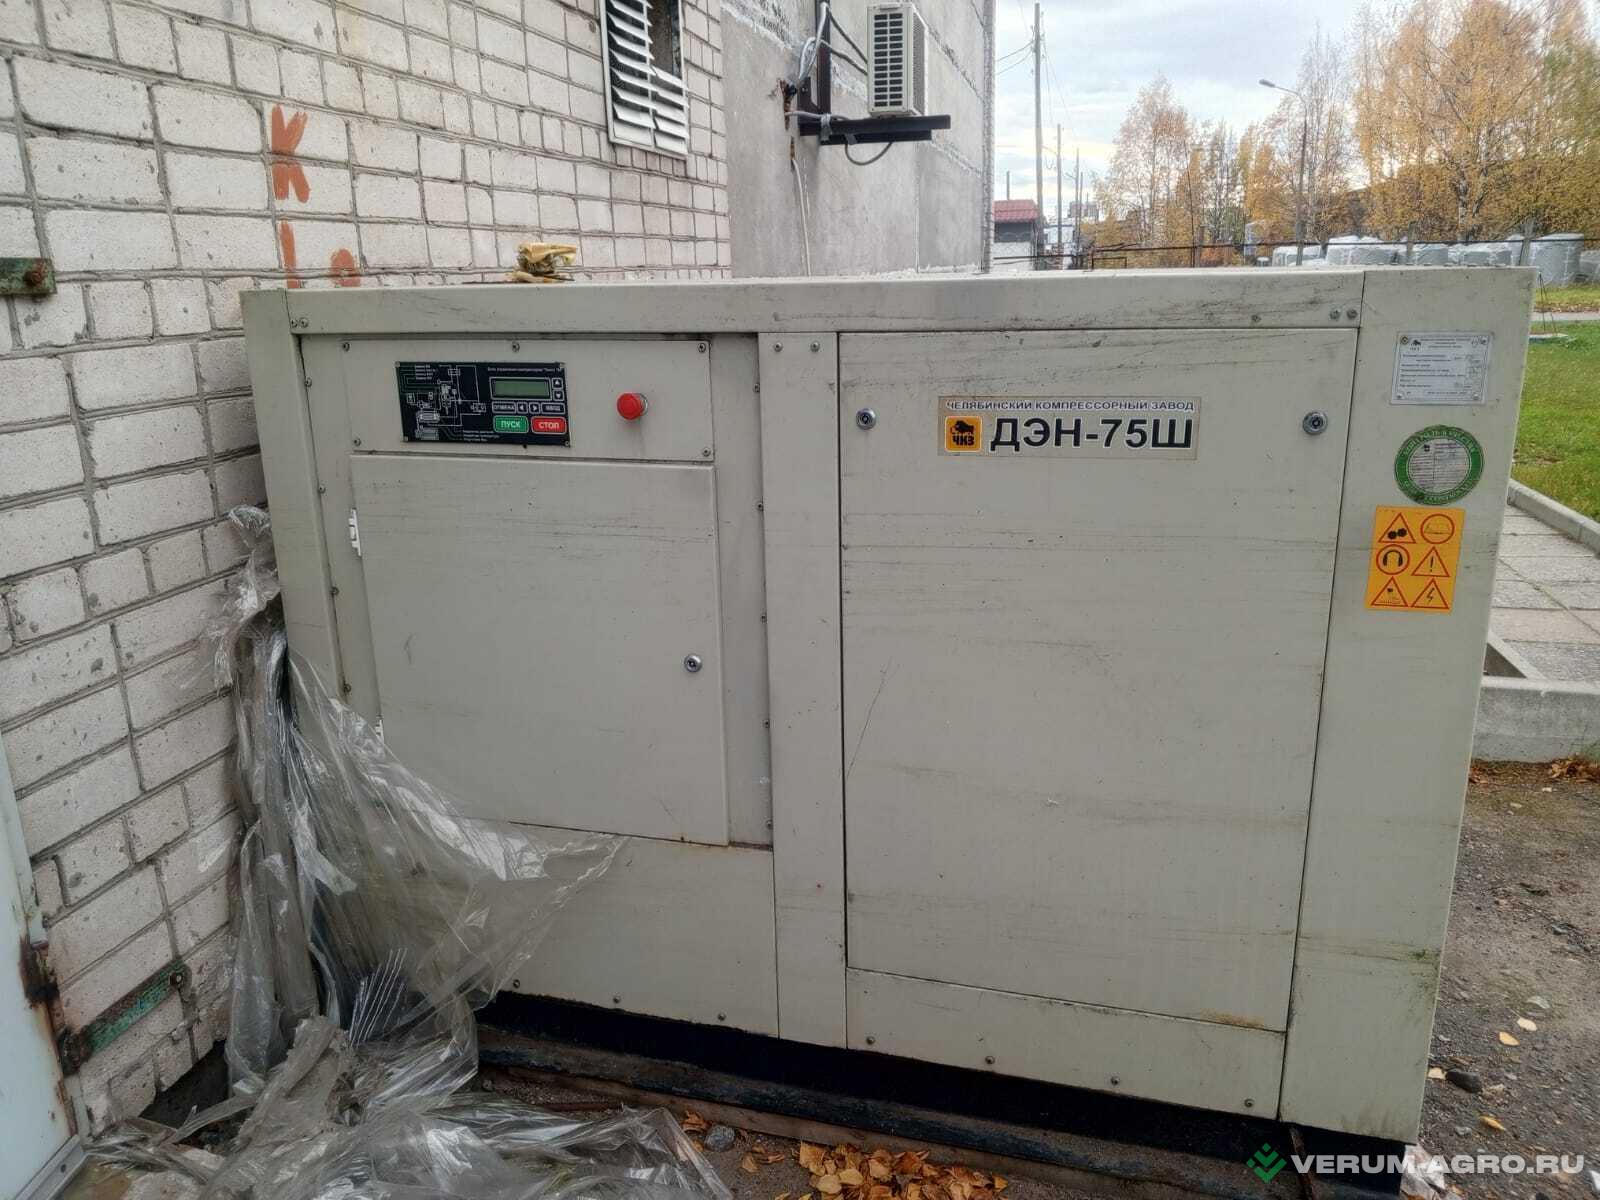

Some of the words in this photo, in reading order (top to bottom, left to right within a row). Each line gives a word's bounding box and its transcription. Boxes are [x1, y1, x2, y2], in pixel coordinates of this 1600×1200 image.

[946, 399, 1033, 412] ЧЕЛЯБИНСКИЙ
[1035, 399, 1149, 412] КОМПРЕССОРНЫЙ
[1151, 400, 1195, 412] ЗАВОД
[500, 420, 521, 429] ПУСК
[538, 421, 560, 430] СТОП
[952, 434, 975, 446] ЧКЗ
[989, 417, 1193, 452] ДЭН-75Ш
